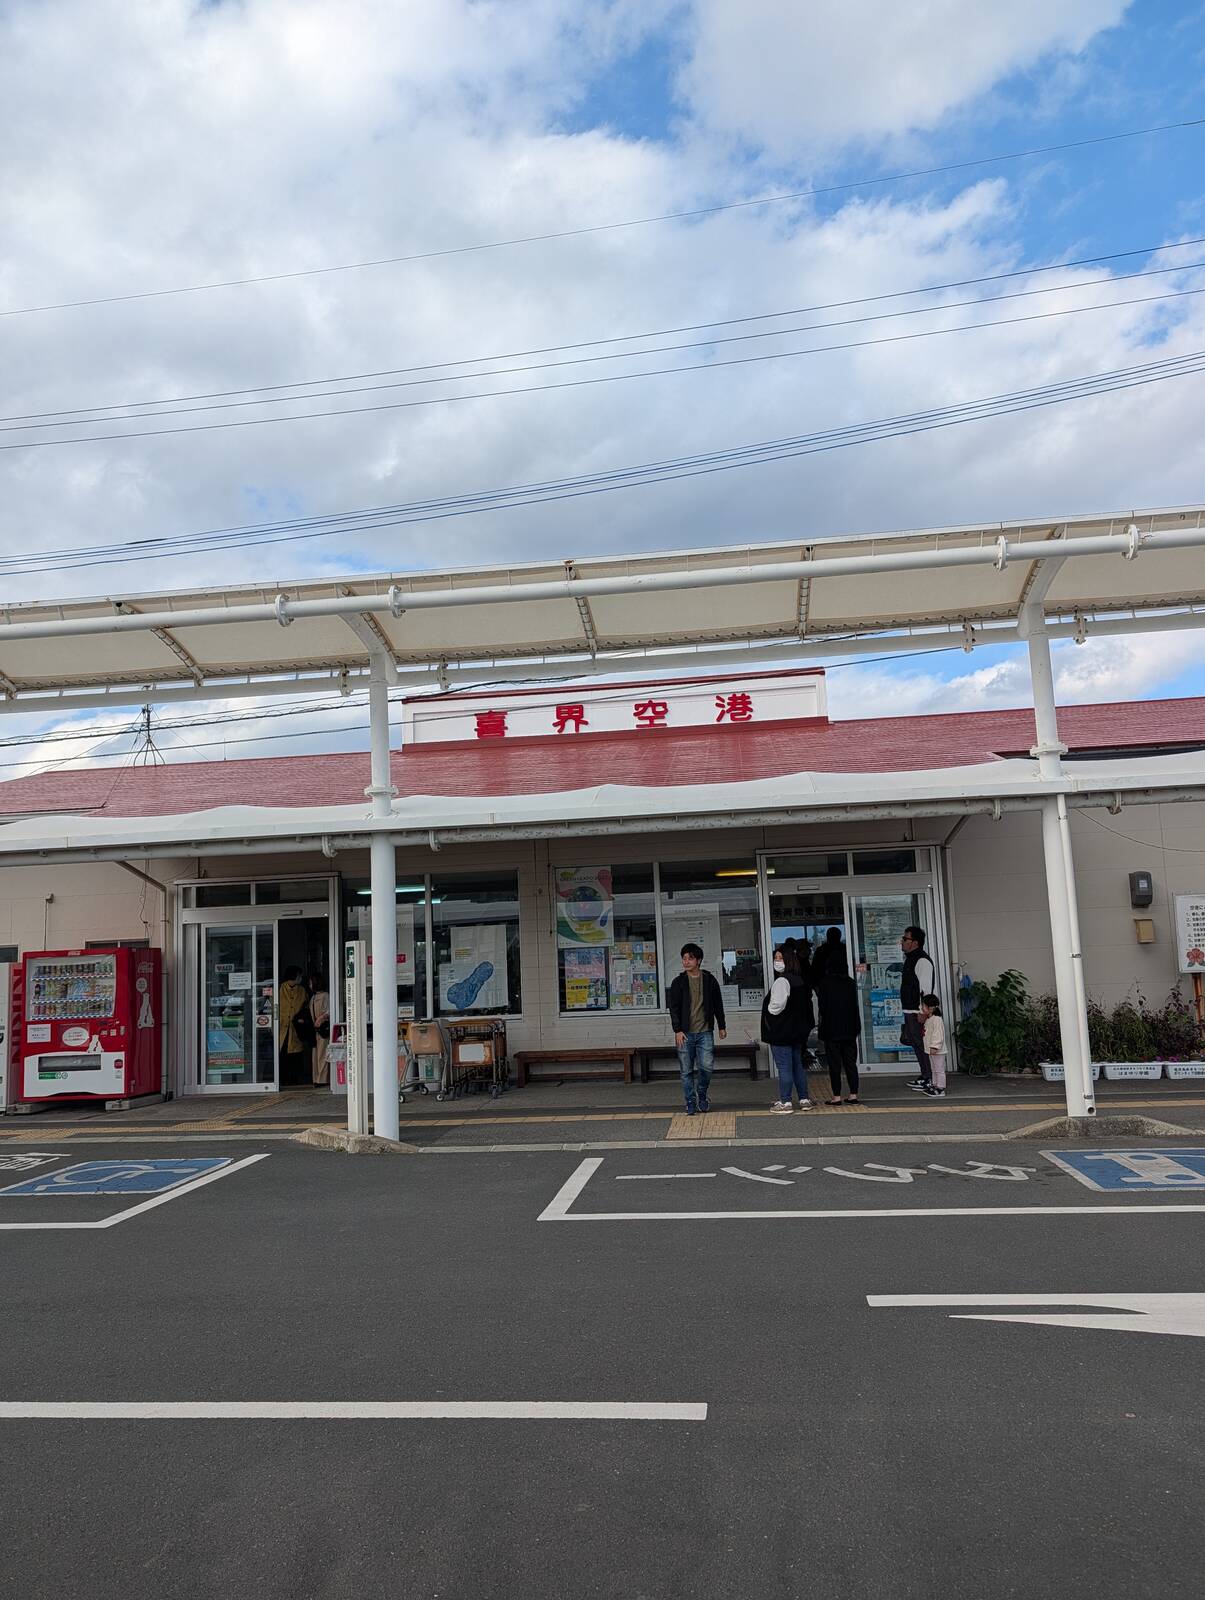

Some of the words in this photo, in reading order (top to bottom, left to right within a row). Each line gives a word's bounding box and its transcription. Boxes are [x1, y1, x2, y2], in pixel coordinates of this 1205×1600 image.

[474, 692, 754, 739] 喜界空港
[615, 1161, 1036, 1185] タクシー
